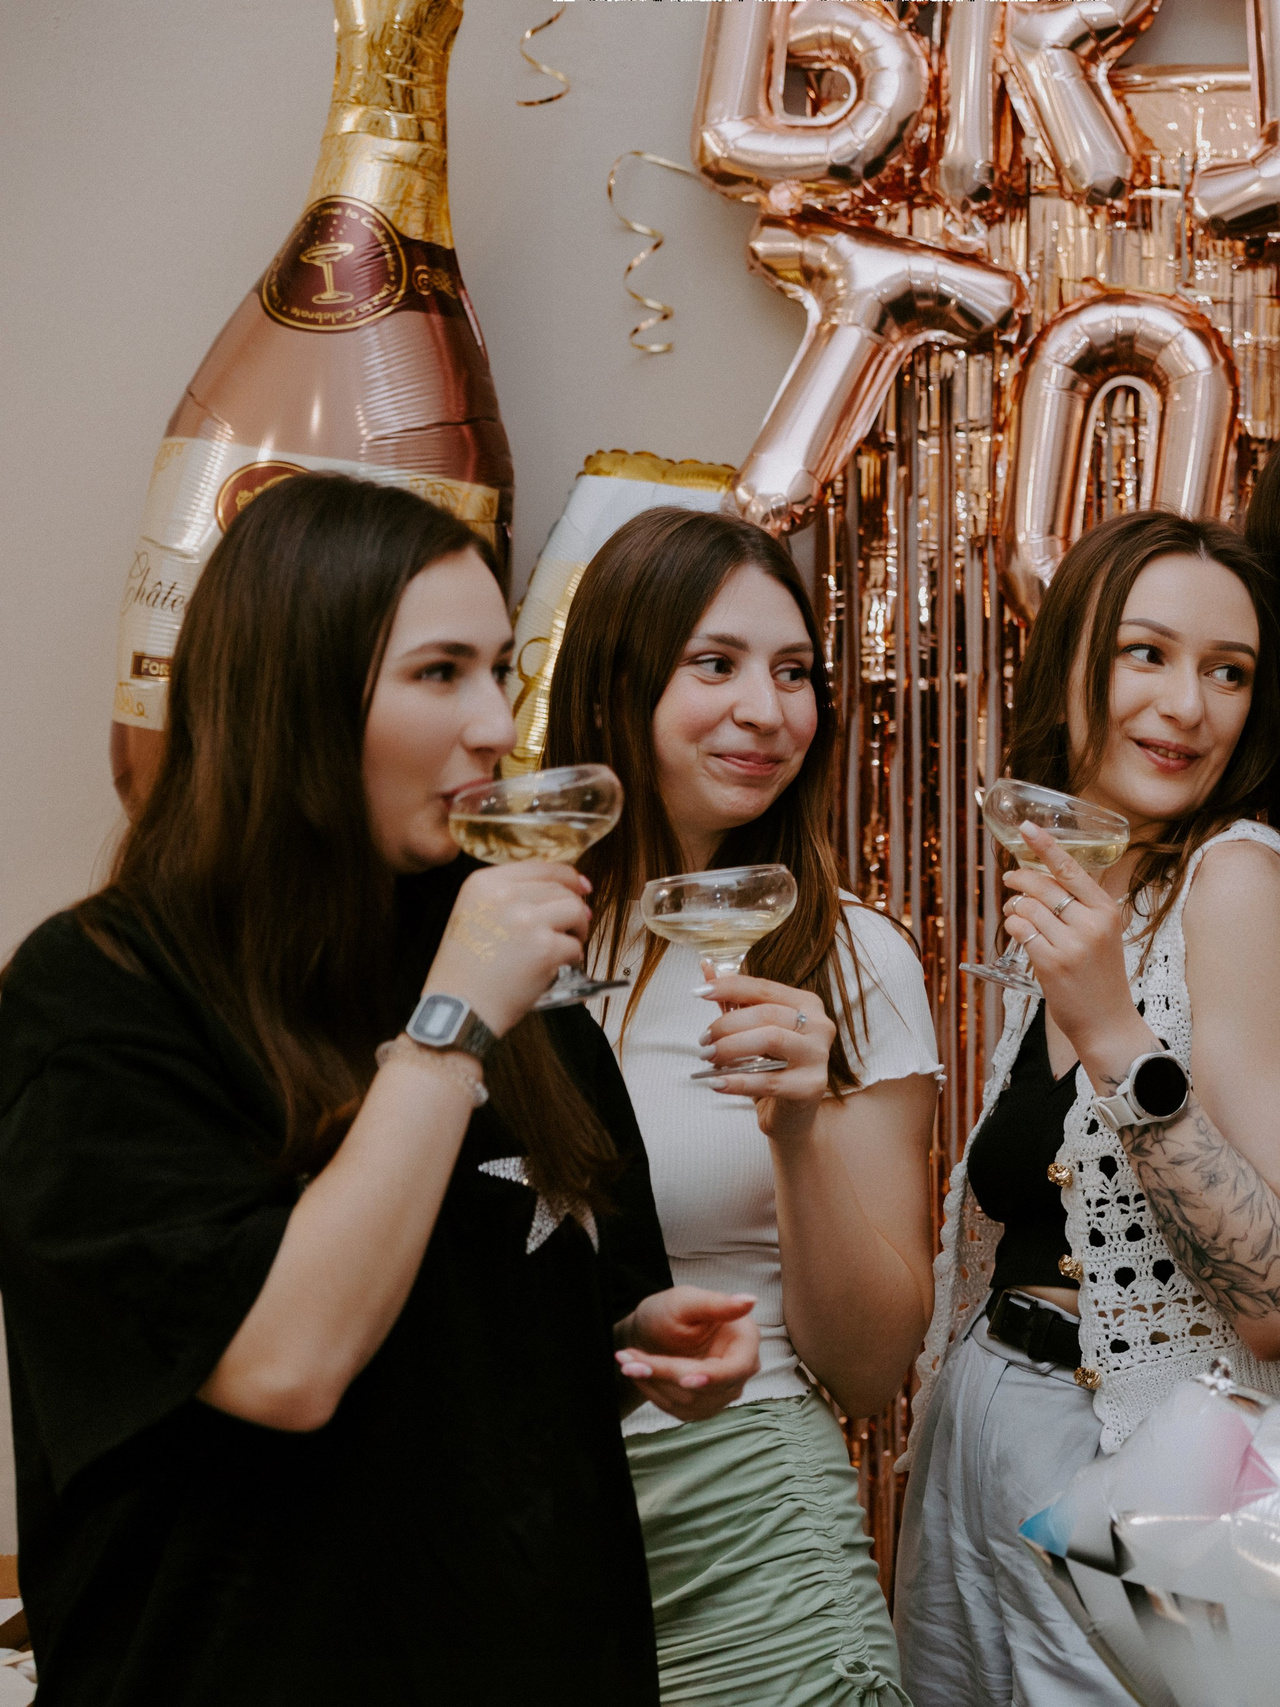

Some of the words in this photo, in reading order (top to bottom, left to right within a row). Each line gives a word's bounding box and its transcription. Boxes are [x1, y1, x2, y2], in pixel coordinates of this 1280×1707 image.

[290, 306, 357, 324] Celebrate
[119, 550, 187, 616] Châte
[140, 658, 170, 676] FOR
